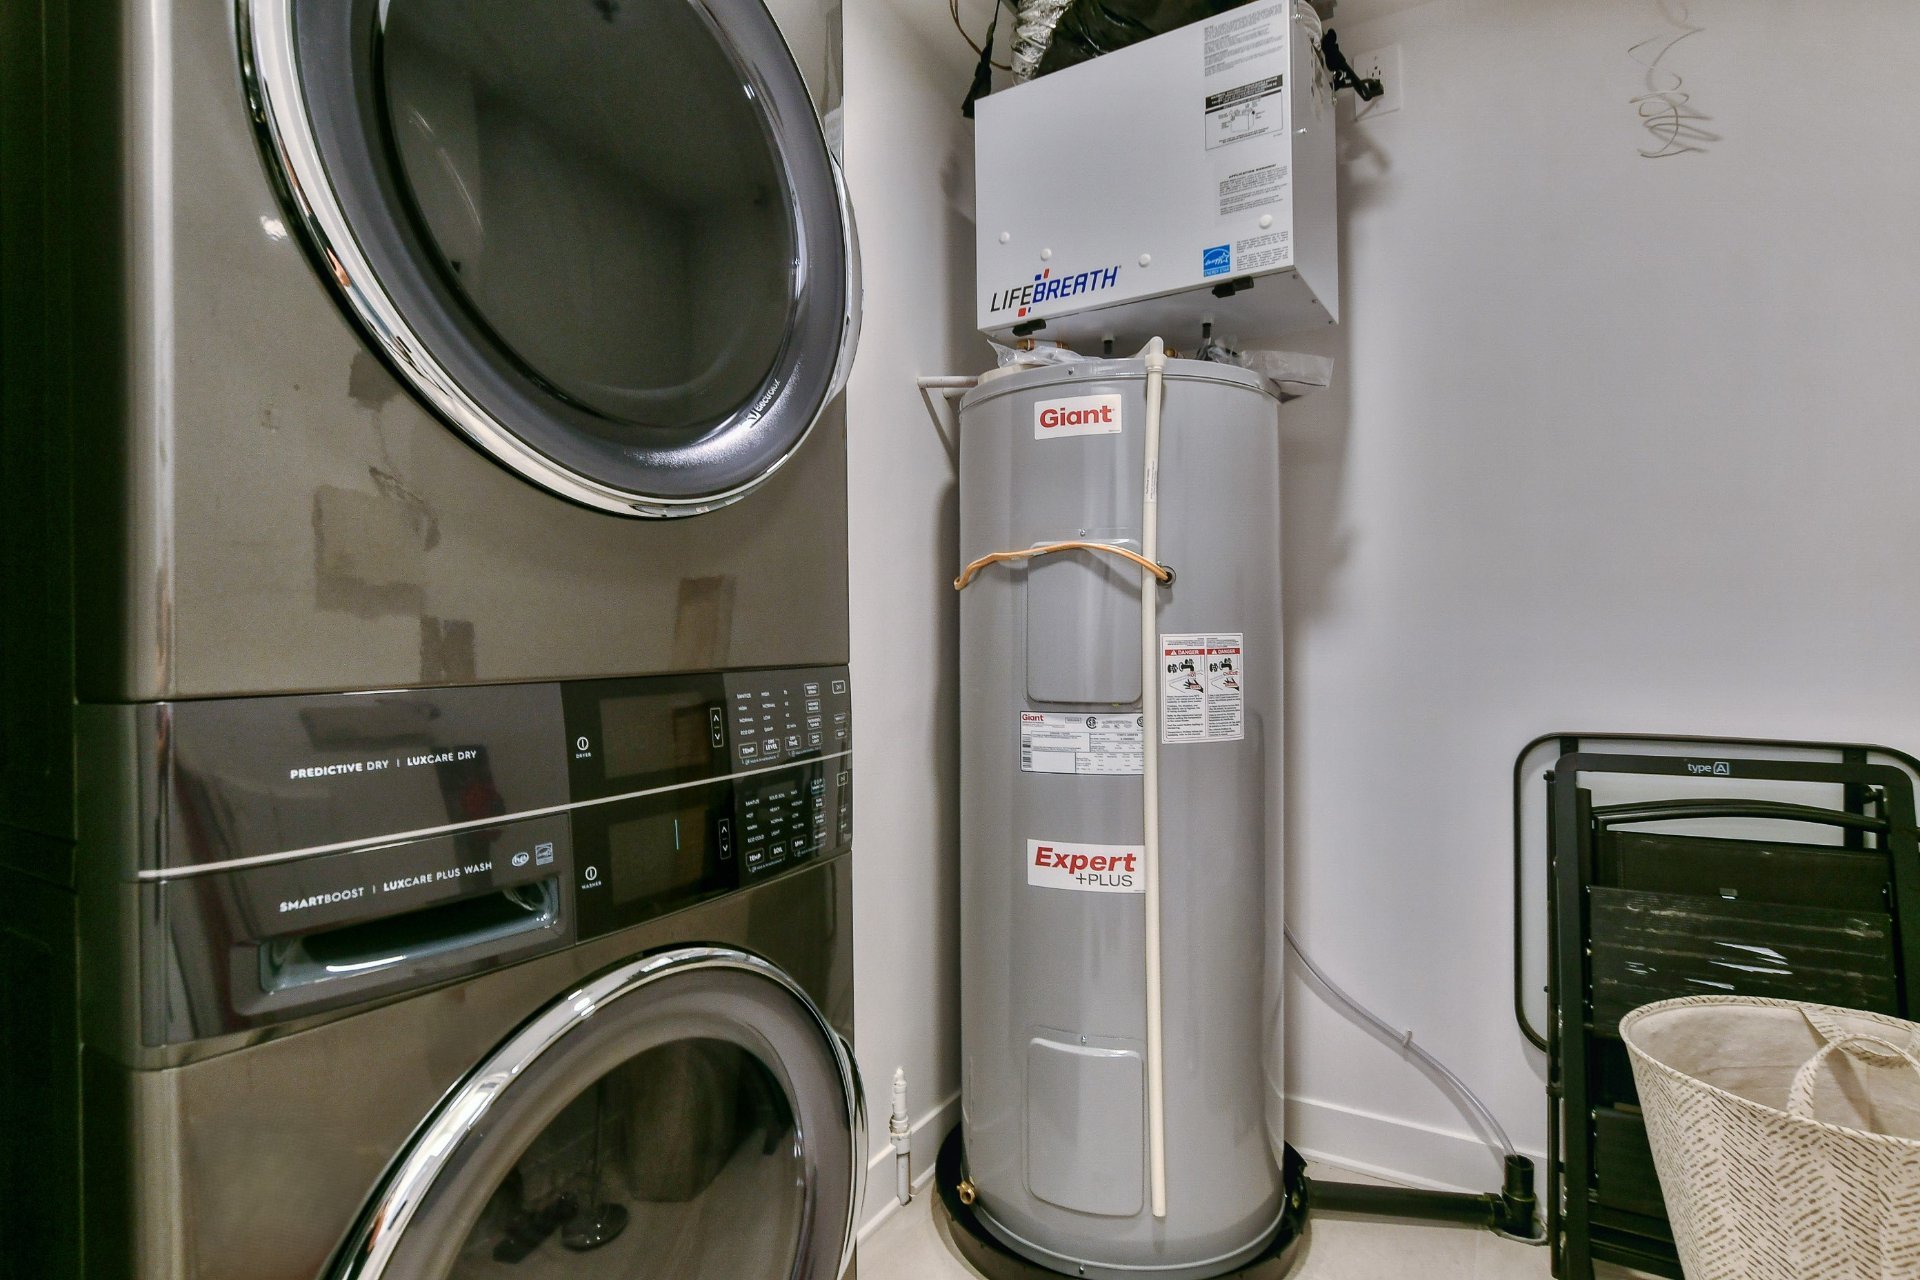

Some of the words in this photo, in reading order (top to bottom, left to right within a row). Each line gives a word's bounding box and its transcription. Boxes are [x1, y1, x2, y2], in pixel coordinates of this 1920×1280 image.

[990, 266, 1118, 312] LIFEBREATH
[1040, 405, 1112, 428] Giant
[290, 762, 363, 779] PREDICTIVE
[366, 759, 389, 771] DRY
[407, 752, 454, 766] LUXCARE
[457, 750, 477, 761] DRY
[1688, 763, 1712, 773] type
[1034, 846, 1136, 874] Expert
[279, 887, 364, 913] SMARTBOOST
[383, 873, 434, 892] LUXCARE
[436, 868, 461, 881] PLUS
[464, 861, 493, 875] WASH
[1076, 873, 1132, 887] +PLUS
